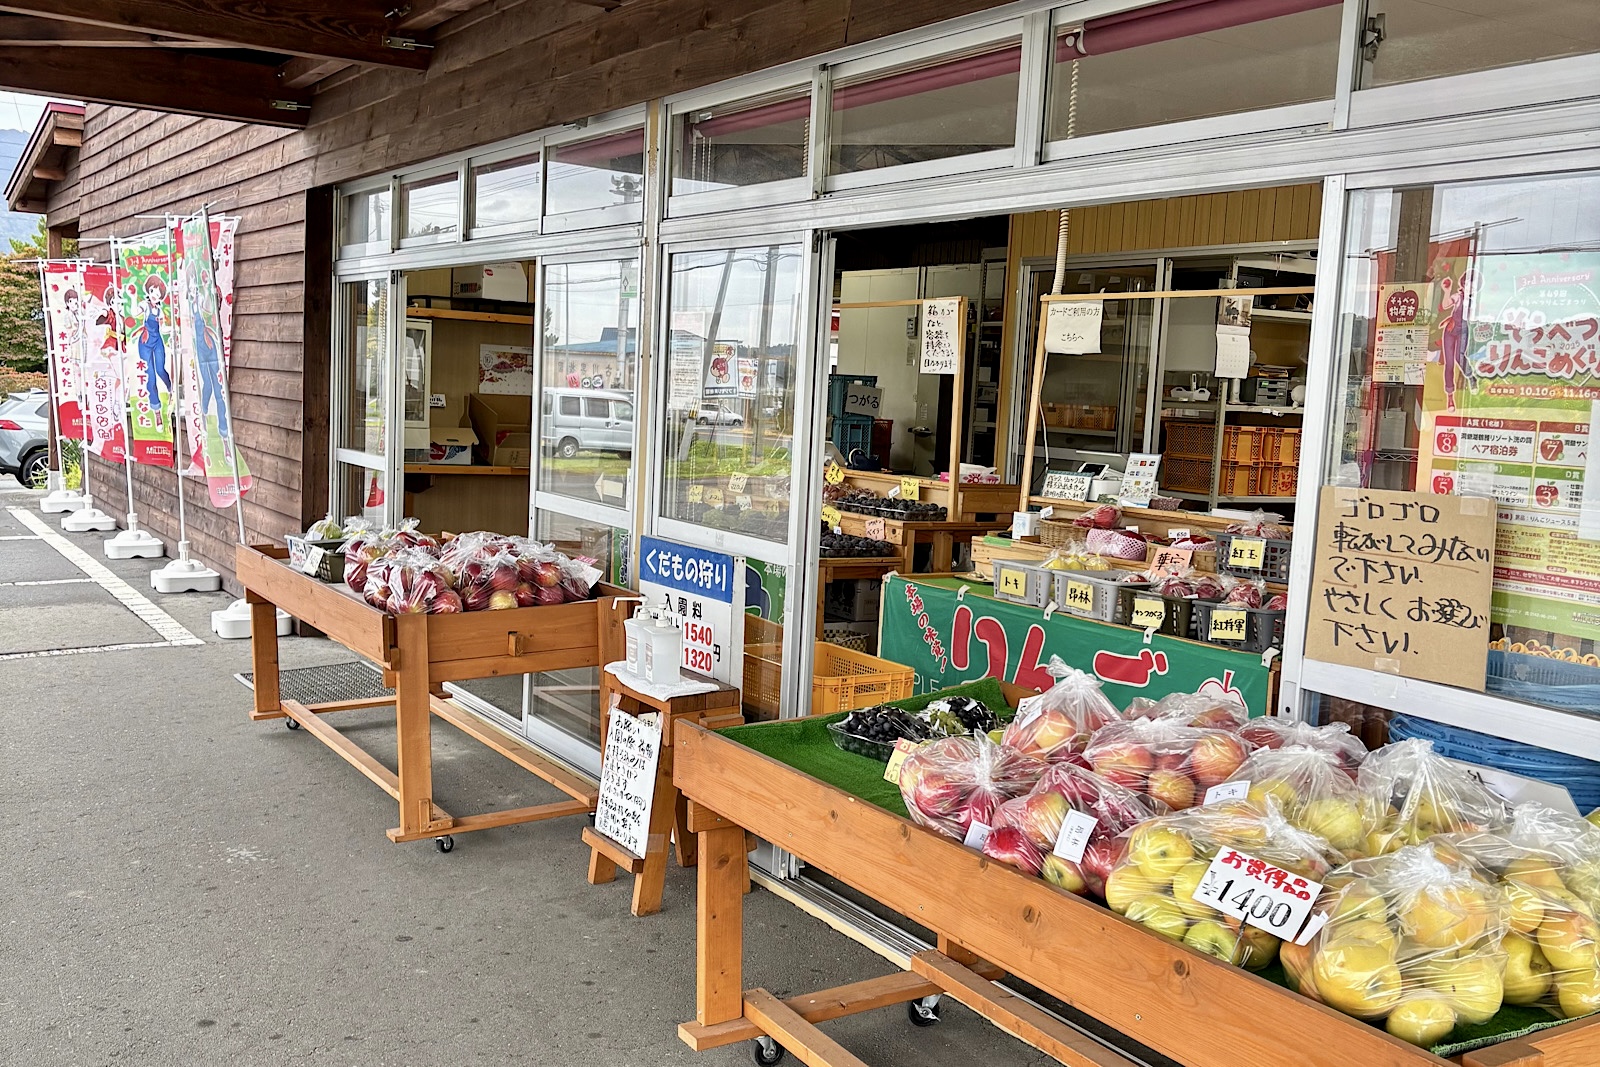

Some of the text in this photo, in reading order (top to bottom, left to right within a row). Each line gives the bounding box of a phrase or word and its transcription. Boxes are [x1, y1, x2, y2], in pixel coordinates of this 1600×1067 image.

[141, 255, 174, 264] Anniversay
[1521, 272, 1591, 287] 3rd Anniversary
[1390, 296, 1416, 306] そうべつ
[1050, 307, 1101, 317] カードご利用の方
[1389, 305, 1416, 317] 物産市
[1061, 333, 1084, 342] こちらへ
[58, 332, 72, 388] 木下ひなた
[136, 361, 152, 427] 木下ひなた
[848, 394, 880, 409] つがる
[95, 378, 111, 440] 木下ひなた
[1442, 437, 1452, 452] 8
[1472, 444, 1519, 457] ペア宿泊券
[1546, 444, 1557, 460] 7
[1438, 481, 1448, 495] 5
[1541, 491, 1552, 507] 3
[1341, 496, 1440, 523] ゴロゴロ
[1332, 521, 1490, 564] 転がしてみない
[1231, 547, 1258, 560] 紅玉
[645, 548, 727, 592] くだもの狩り
[1004, 577, 1019, 591] トキ
[1068, 588, 1092, 606] 昂林
[1323, 587, 1398, 620] やさしく
[1135, 609, 1163, 620] サンつがる
[684, 621, 713, 647] 1540
[1212, 618, 1246, 634] 紅将軍
[713, 643, 721, 663] 円
[952, 604, 1168, 694] りんご
[684, 647, 713, 672] 1320
[914, 674, 940, 695] PLE
[1220, 850, 1312, 901] お買得品
[1201, 870, 1293, 928] ¥1400
